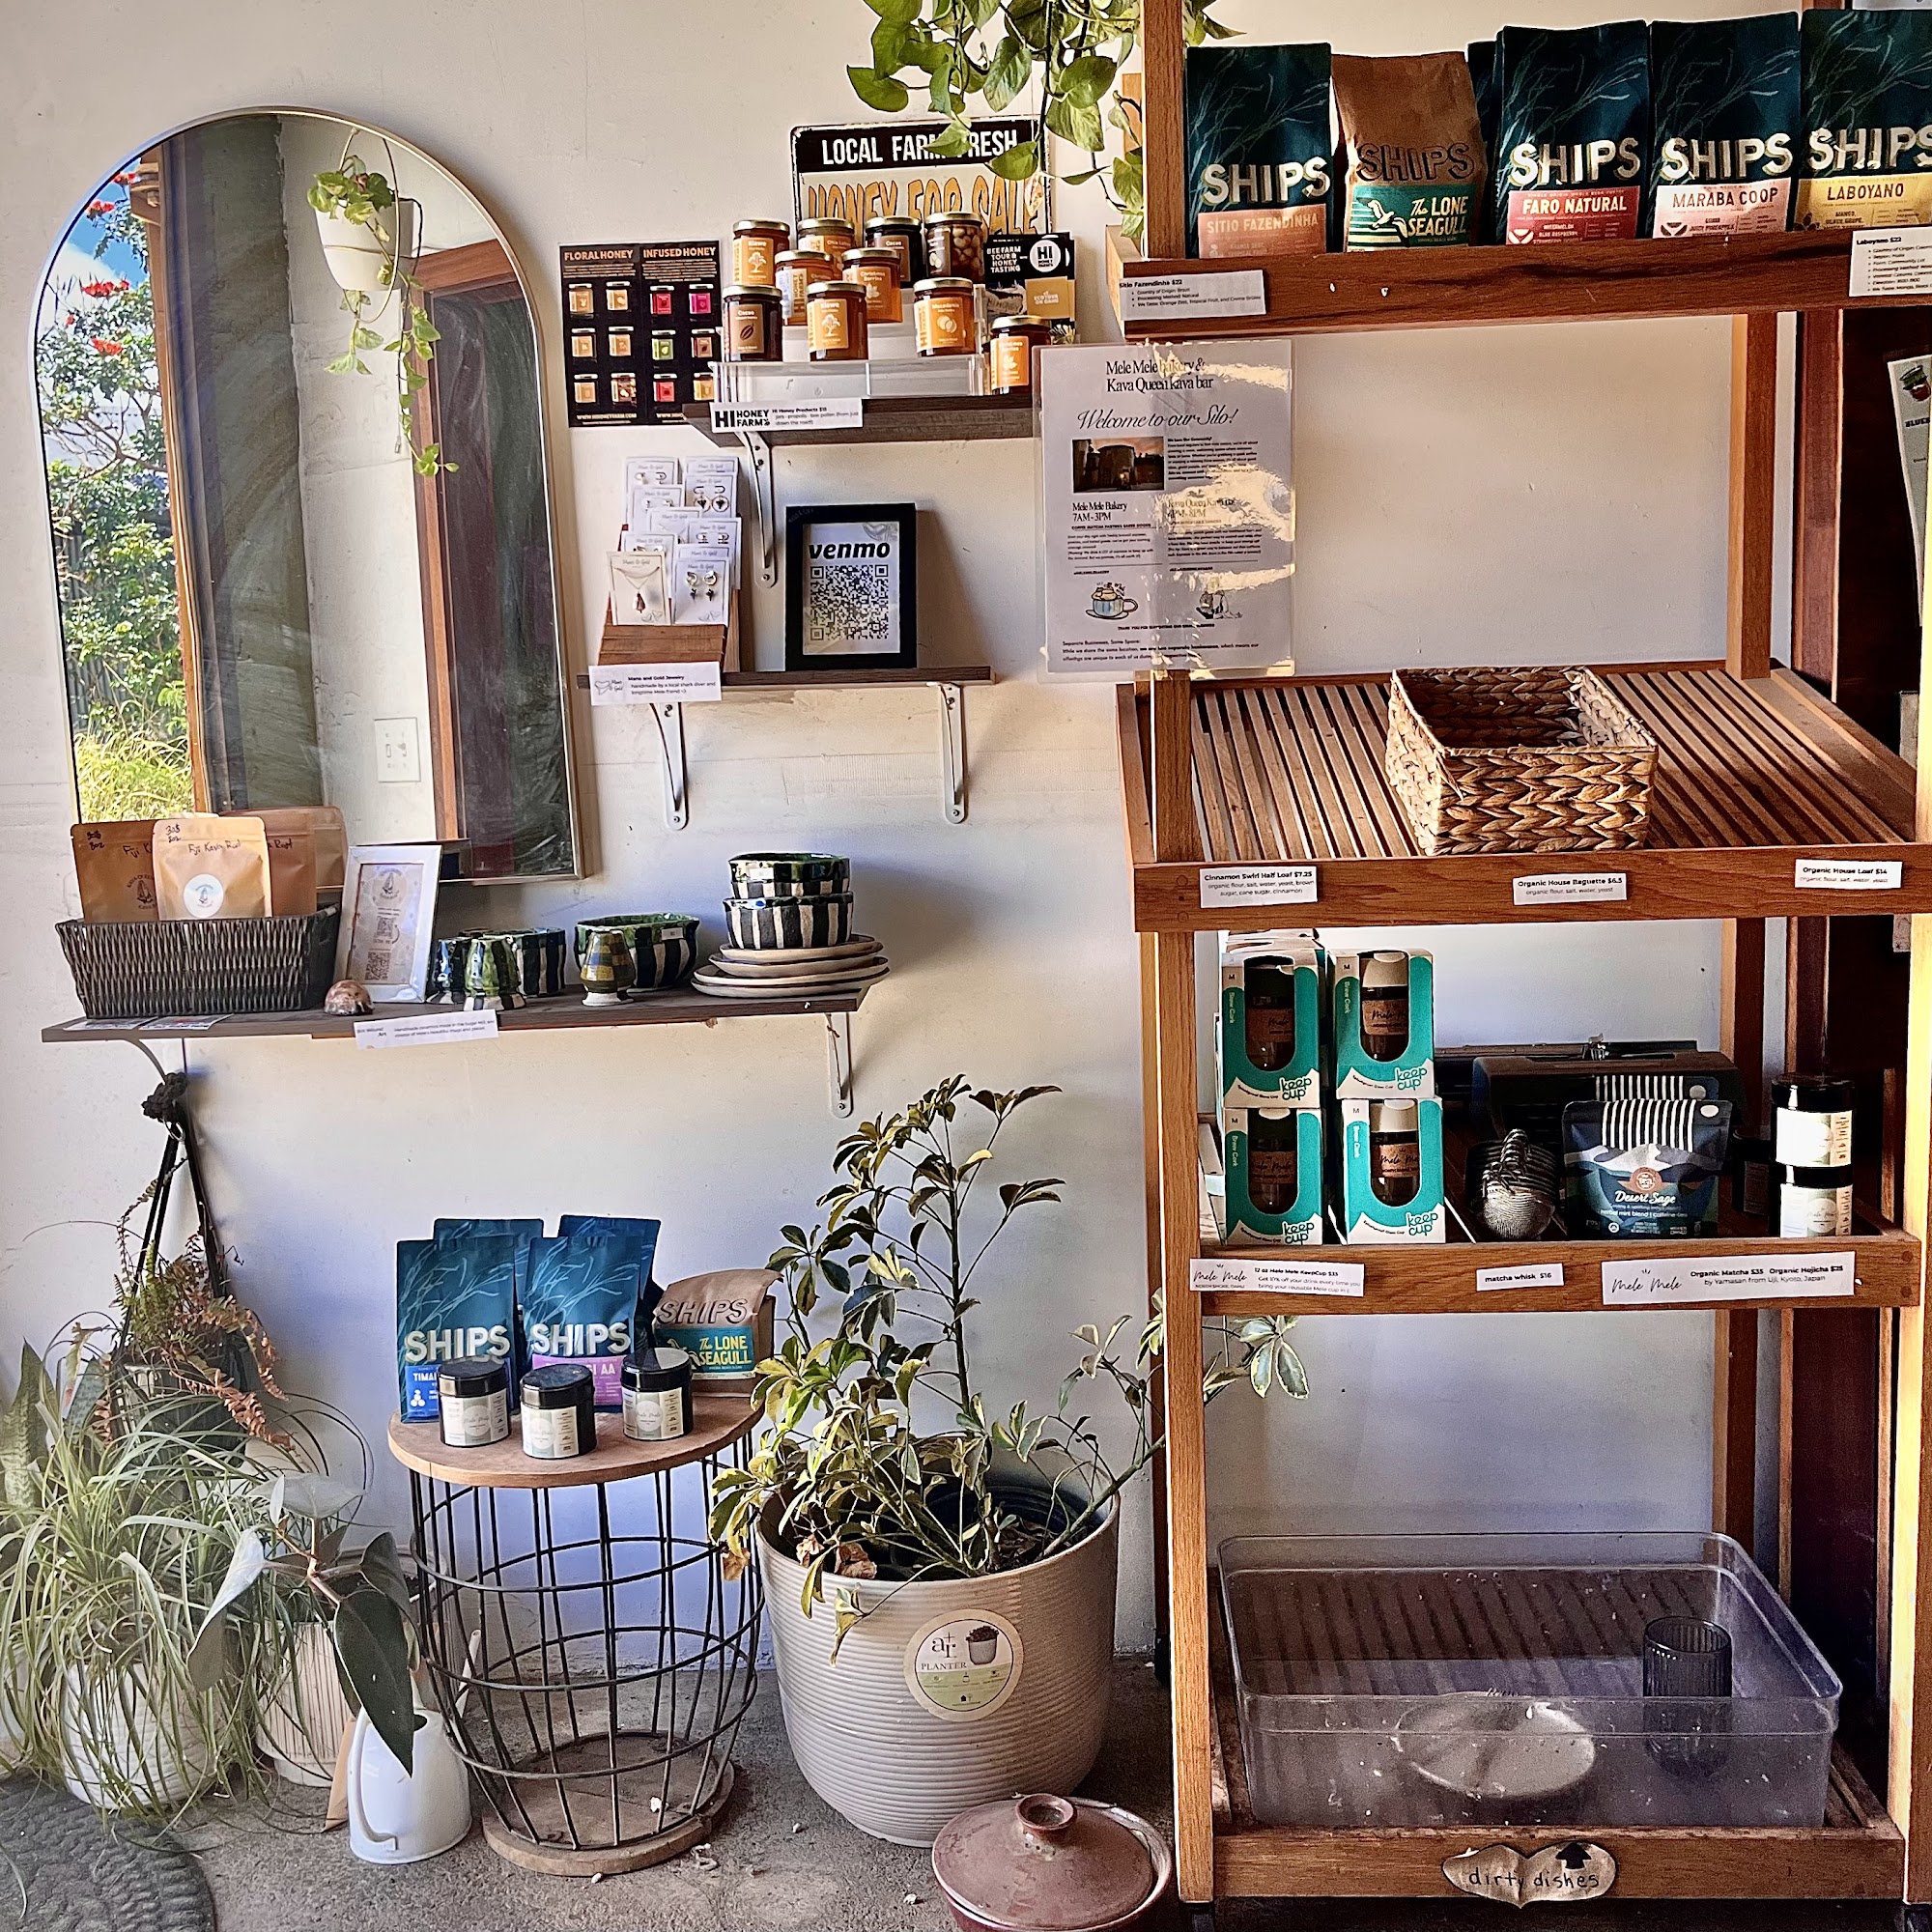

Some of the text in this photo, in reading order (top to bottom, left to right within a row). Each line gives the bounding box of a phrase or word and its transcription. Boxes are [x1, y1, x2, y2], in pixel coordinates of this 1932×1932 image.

[821, 136, 884, 165] LOCAL
[959, 129, 1017, 157] RESH
[1809, 125, 1932, 171] SHIPS
[1356, 142, 1476, 184] SHIPS
[1508, 137, 1640, 186] SHIPS
[1660, 132, 1793, 181] SHIPS
[1201, 156, 1331, 206] SHIPS
[1672, 191, 1735, 208] MARABA
[1827, 183, 1904, 201] LABOYANO
[1411, 196, 1469, 215] The LONE
[1522, 196, 1627, 214] FARO NATURAL
[1243, 213, 1320, 233] FAZENDINHA
[1407, 215, 1467, 237] SEAGULL
[564, 249, 635, 261] FLORAL HONEY
[642, 246, 717, 258] INFUSED HONEY
[1037, 245, 1053, 260] HI
[990, 265, 1021, 274] TASTING
[1106, 359, 1195, 376] Mele Mele bakery
[1107, 375, 1214, 394] Kava Queen kava bar
[715, 410, 735, 428] HI
[736, 410, 770, 419] HONEY
[1077, 404, 1239, 431] Welcome to our Silo!
[1072, 500, 1128, 512] Mele Mele Bakery
[809, 542, 891, 559] venmo
[124, 845, 142, 859] Fiji
[189, 841, 226, 856] Fiji Kava
[1803, 867, 1832, 875] Organic
[1517, 879, 1547, 888] Organic
[1548, 878, 1571, 887] House
[1572, 877, 1606, 887] Baguette
[1597, 886, 1614, 895] yeast
[1396, 1066, 1429, 1082] keep
[1280, 1077, 1313, 1093] keep
[1397, 1077, 1422, 1091] cup
[1282, 1087, 1307, 1101] cup
[1614, 1190, 1677, 1207] Desert Sage
[1406, 1211, 1439, 1226] keep
[1283, 1222, 1316, 1236] keep
[1407, 1223, 1434, 1236] cup
[1284, 1233, 1309, 1245] cup
[1193, 1270, 1248, 1284] Mele Mele
[1690, 1269, 1720, 1279] Organic
[1769, 1266, 1800, 1276] Organic
[1801, 1265, 1830, 1274] Hojicha
[1803, 1274, 1827, 1283] Japan
[1611, 1275, 1683, 1293] Mele Mele
[656, 1297, 749, 1324] SHIPS
[406, 1324, 511, 1363] SHIPS
[530, 1323, 633, 1357] SHIPS
[699, 1336, 749, 1350] The LONE
[698, 1350, 753, 1366] SEAGULL
[921, 1661, 968, 1671] PLANTER
[1468, 1867, 1600, 1900] dirty dishes
